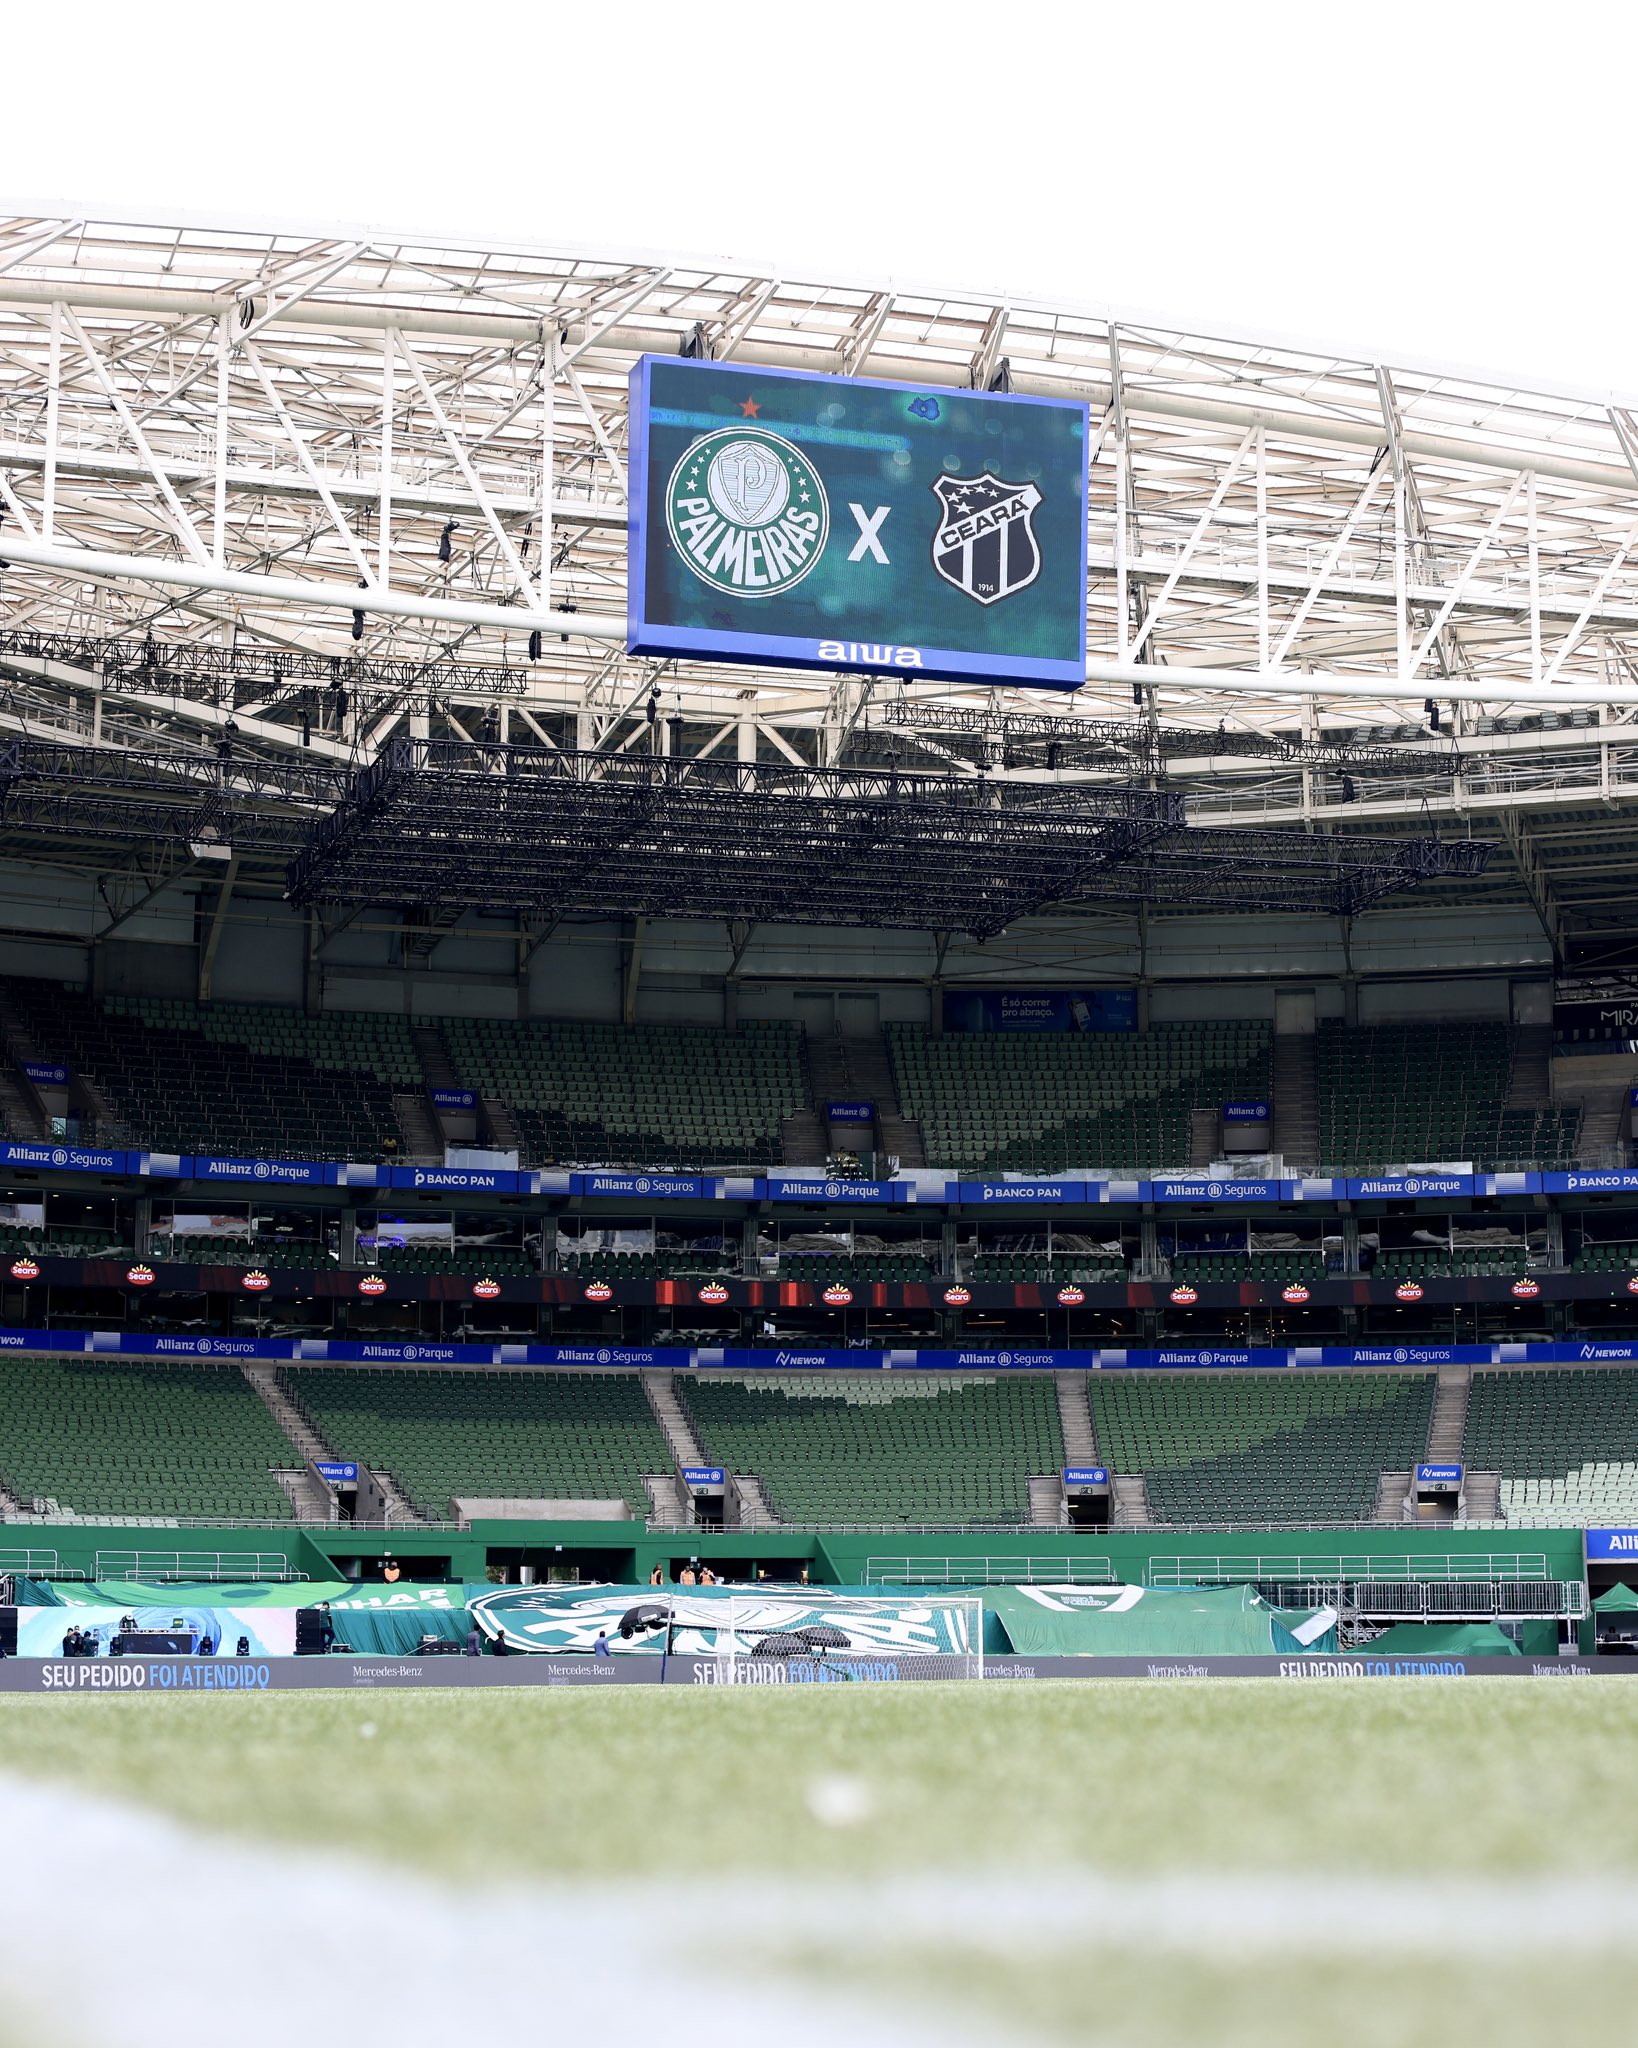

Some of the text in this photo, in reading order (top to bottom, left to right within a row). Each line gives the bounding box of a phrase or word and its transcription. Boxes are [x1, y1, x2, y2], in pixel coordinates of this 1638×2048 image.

[940, 494, 1029, 550] CEARÁ
[847, 503, 892, 565] X
[676, 497, 820, 586] PALMEIRAS
[977, 582, 995, 593] 1914
[818, 640, 924, 668] aiwa
[1002, 996, 1051, 1007] É só correr
[1002, 1007, 1055, 1018] pro abraço.
[434, 1093, 461, 1103] Allianz
[831, 1107, 858, 1117] Allianz
[1228, 1107, 1255, 1117] Allianz
[7, 1147, 113, 1168] Allianz Seguros
[208, 1161, 310, 1179] Allianz Parque
[426, 1174, 495, 1187] BANCO PAN
[592, 1178, 694, 1194] Allianz Seguros
[1360, 1178, 1461, 1193] Allianz Parque
[1579, 1175, 1621, 1188] BANCO
[781, 1183, 880, 1198] Allianz Parque
[995, 1187, 1062, 1198] BANCO PAN
[1165, 1183, 1267, 1198] Allianz Seguros
[12, 1266, 37, 1276] Seara
[128, 1272, 153, 1282] Seara
[243, 1278, 268, 1287] Seara
[360, 1282, 385, 1291] Seara
[474, 1285, 499, 1294] Seara
[1512, 1285, 1538, 1294] Seara
[587, 1288, 610, 1297] Seara
[700, 1290, 726, 1300] Seara
[825, 1292, 851, 1302] Seara
[945, 1292, 970, 1302] Seara
[1059, 1292, 1083, 1301] Seara
[1171, 1292, 1196, 1301] Seara
[1283, 1290, 1308, 1299] Seara
[1397, 1288, 1422, 1297] Seara
[155, 1338, 255, 1354] Allianz Seguros
[362, 1345, 454, 1361] Allianz Parque
[556, 1350, 653, 1364] Allianz Seguros
[1354, 1348, 1451, 1362] Allianz Seguros
[1595, 1348, 1631, 1357] NEWON
[790, 1356, 826, 1365] NEWON
[958, 1353, 1054, 1366] Allianz Seguros
[1158, 1352, 1249, 1365] Allianz Parque
[684, 1471, 710, 1480] Allianz
[1067, 1471, 1093, 1480] Allianz
[352, 1665, 423, 1677] Mercedes-Benz
[547, 1664, 616, 1676] Mercedes-Benz
[41, 1664, 270, 1689] SEU PEDIDO FOI ATENDIDO
